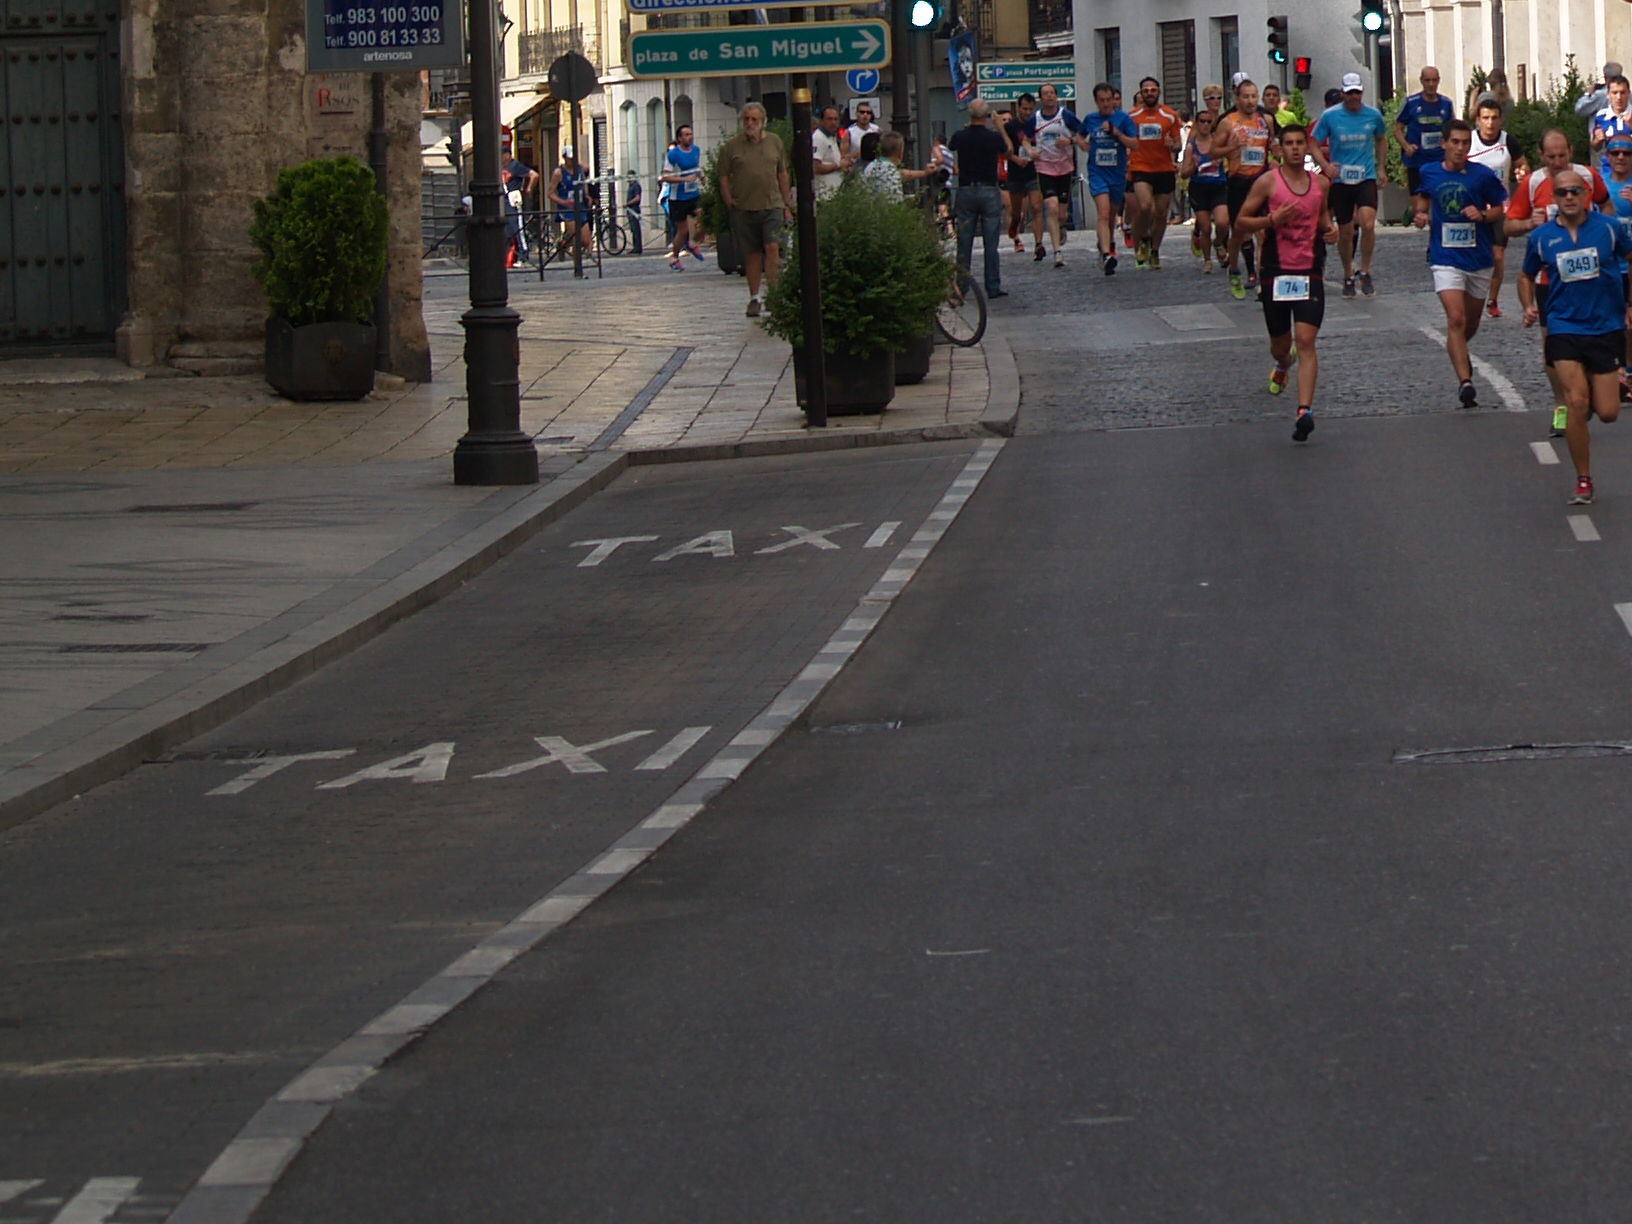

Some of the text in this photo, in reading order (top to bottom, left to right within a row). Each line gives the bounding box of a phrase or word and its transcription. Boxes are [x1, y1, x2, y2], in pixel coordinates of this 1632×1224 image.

[325, 6, 440, 25] Telf. 983 100 300
[325, 28, 441, 47] Telf. 900 81 33 33
[363, 51, 412, 62] artenosa
[636, 38, 842, 66] plaza de San Miguel
[1024, 67, 1074, 77] Portugalete
[1450, 229, 1468, 241] 723
[1567, 256, 1591, 273] 349
[1285, 281, 1298, 293] 74
[569, 521, 901, 567] TAXI
[205, 726, 711, 795] TAXI
